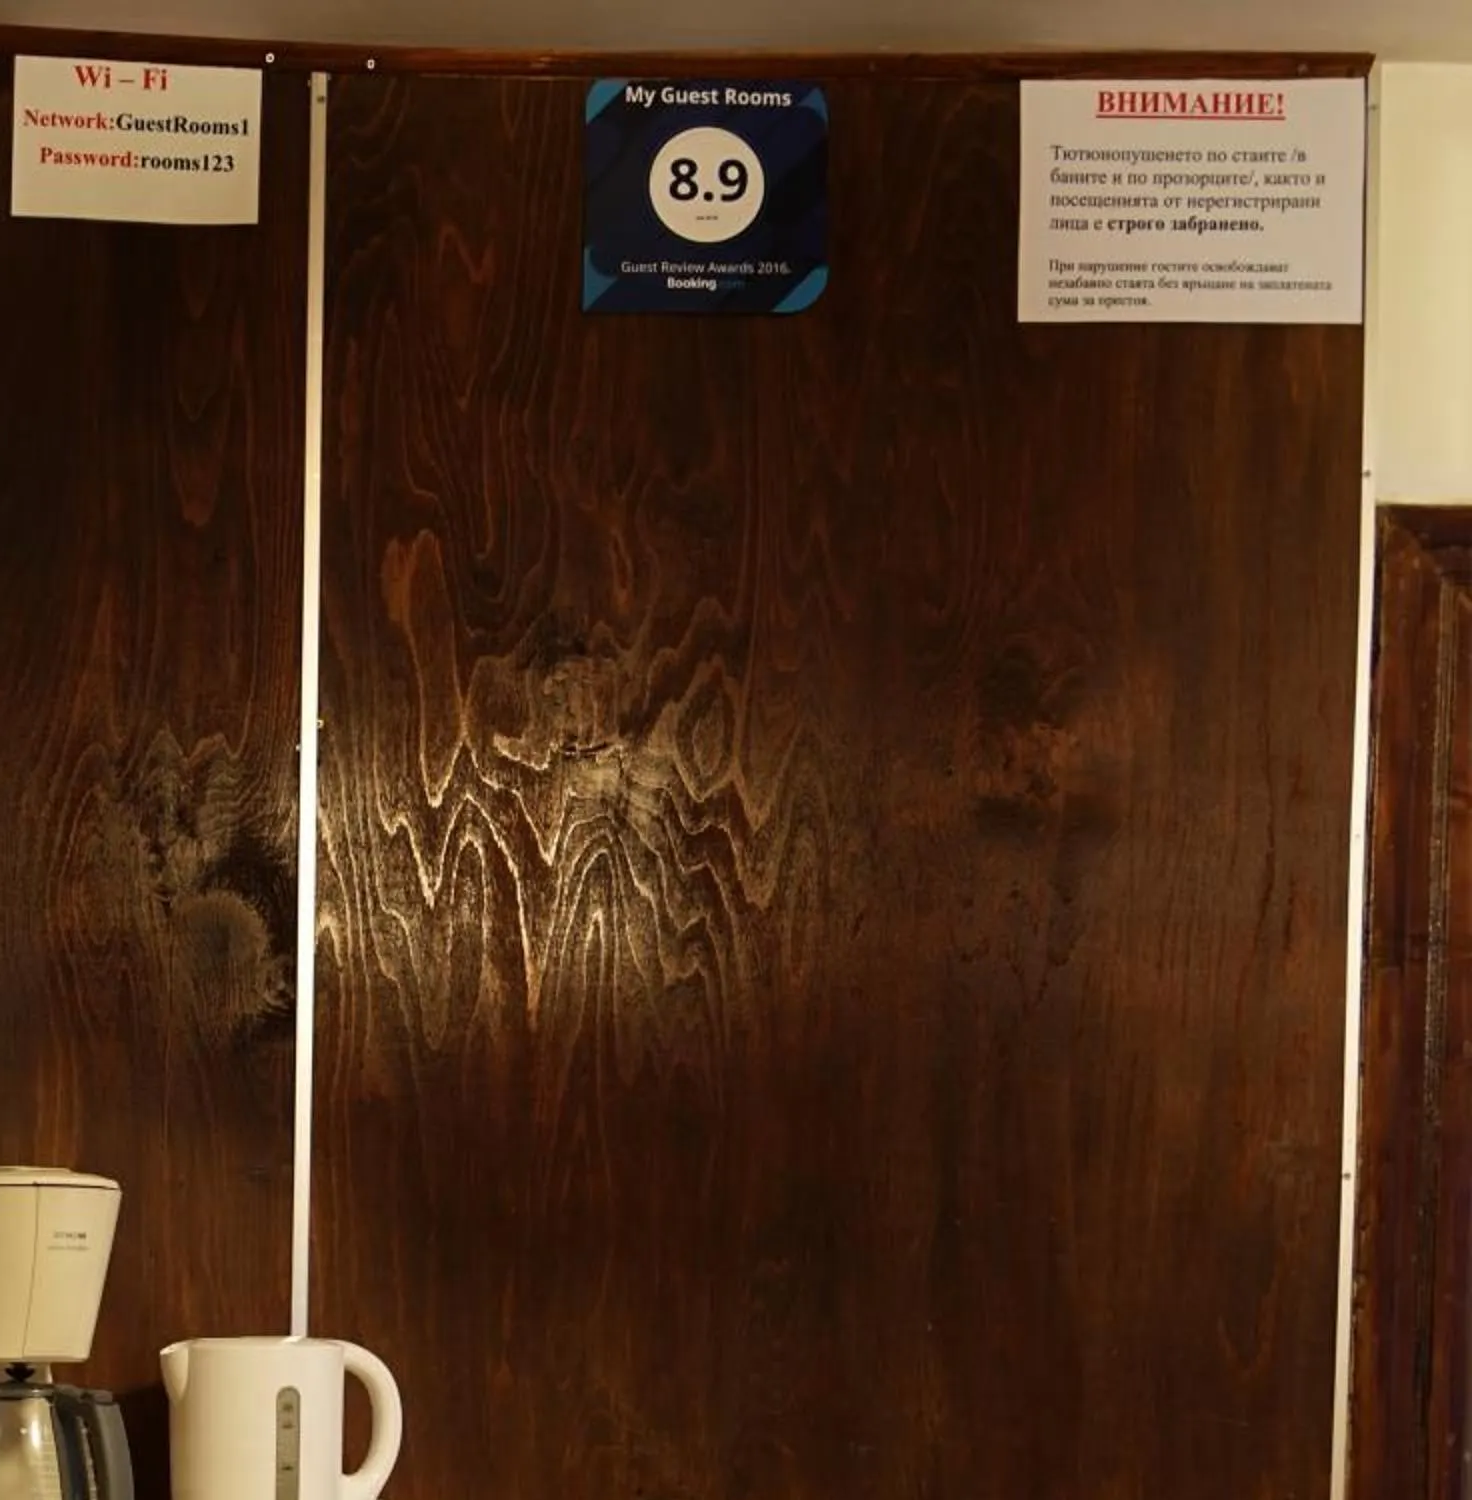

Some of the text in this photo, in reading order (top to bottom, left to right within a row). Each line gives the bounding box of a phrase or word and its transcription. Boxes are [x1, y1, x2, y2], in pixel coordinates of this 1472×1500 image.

[74, 65, 112, 89] Wi
[142, 68, 168, 91] Fi
[625, 86, 793, 108] My Guest Rooms
[1097, 91, 1285, 116] ВНИМАНИЕ!
[23, 108, 250, 136] Network:GuestRooms1
[39, 147, 235, 173] Password:rooms123
[1207, 151, 1227, 163] по
[1231, 151, 1287, 163] стаите
[668, 157, 749, 203] 8.9
[1049, 167, 1107, 185] баните
[1112, 173, 1122, 185] и
[1127, 173, 1147, 185] по
[1315, 174, 1326, 186] и
[1163, 196, 1181, 209] от
[1093, 218, 1104, 231] е
[1107, 218, 1166, 235] строго
[1171, 215, 1265, 236] забранено.
[621, 261, 658, 273] Guest
[661, 261, 705, 273] Review
[707, 261, 754, 274] Awards
[1048, 258, 1075, 275] При
